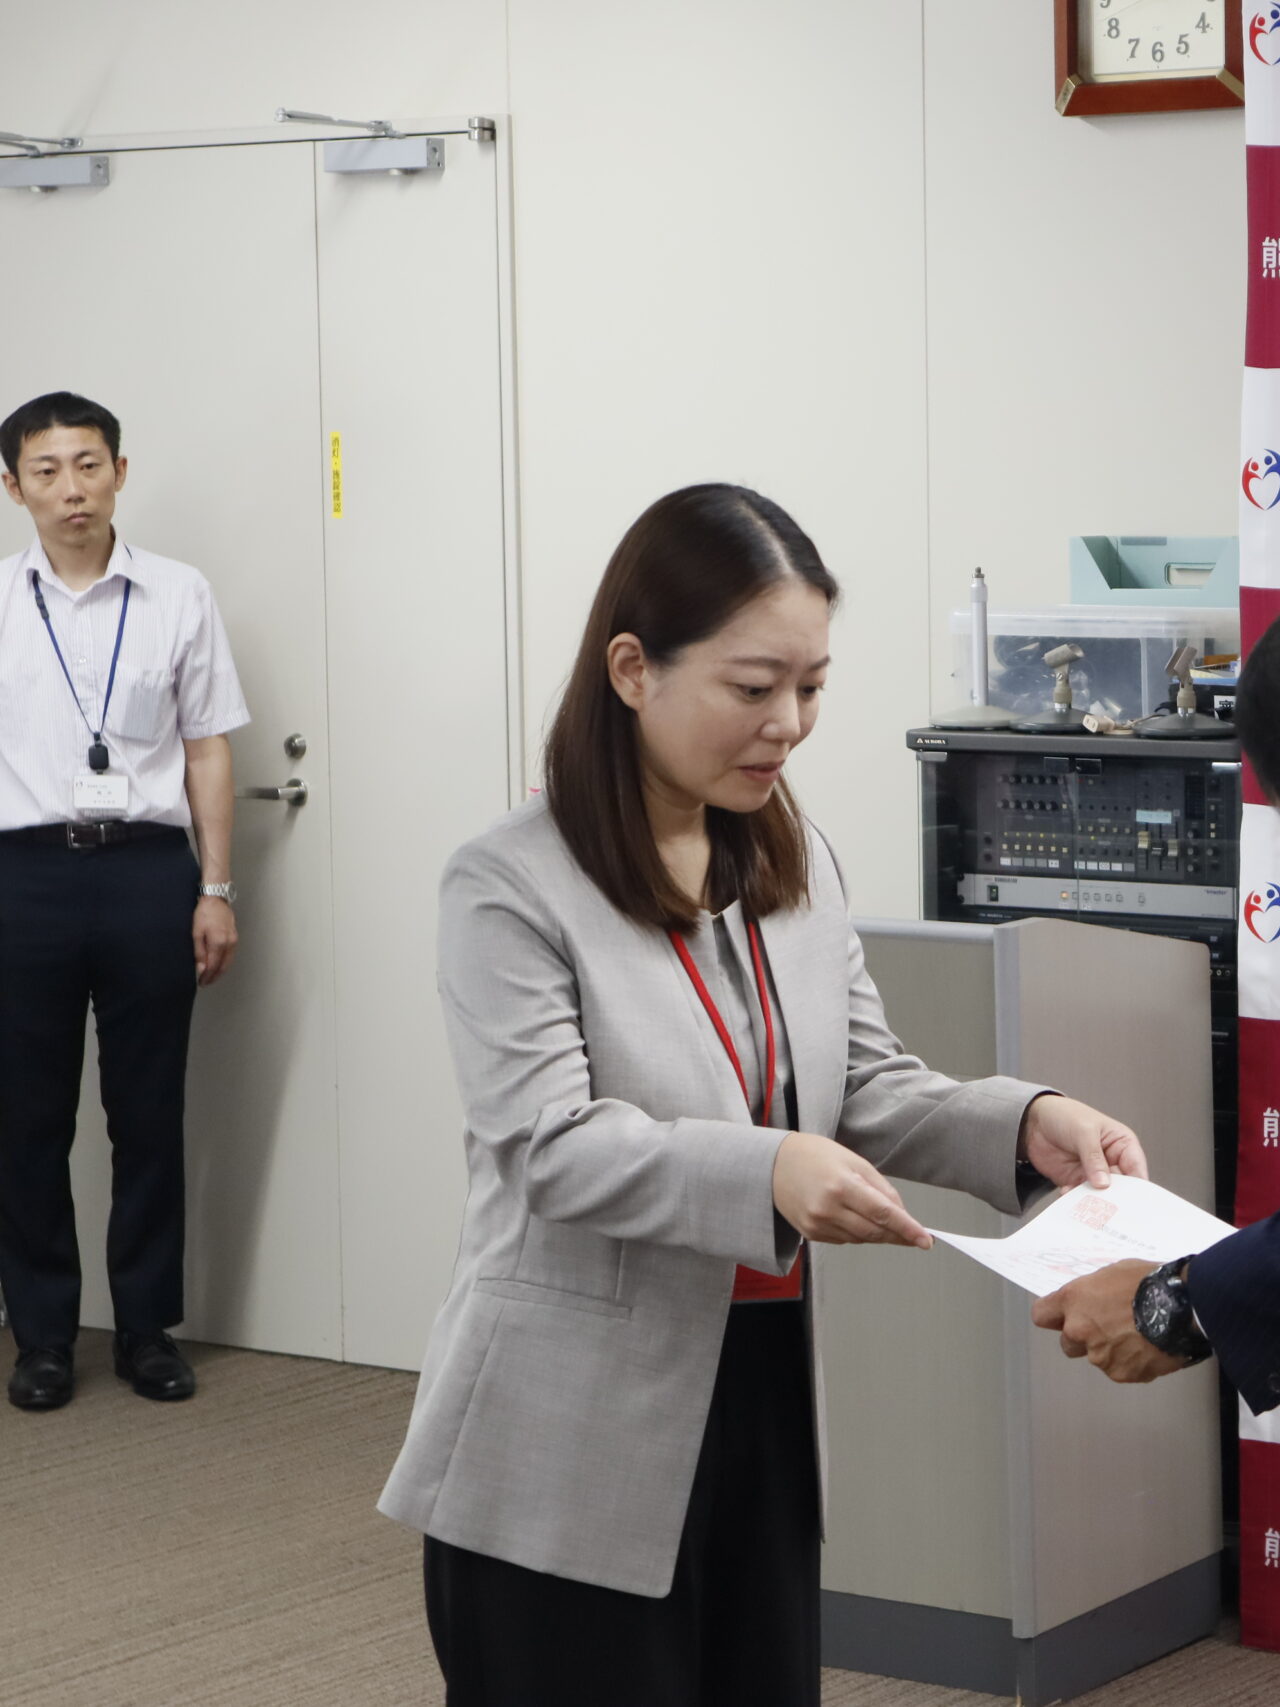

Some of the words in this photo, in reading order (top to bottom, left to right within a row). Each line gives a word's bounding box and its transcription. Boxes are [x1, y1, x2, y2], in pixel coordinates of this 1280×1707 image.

[1106, 17, 1120, 38] 8
[1195, 12, 1210, 33] 4
[1128, 38, 1140, 58] 7
[1151, 42, 1165, 63] 6
[1176, 34, 1190, 55] 5
